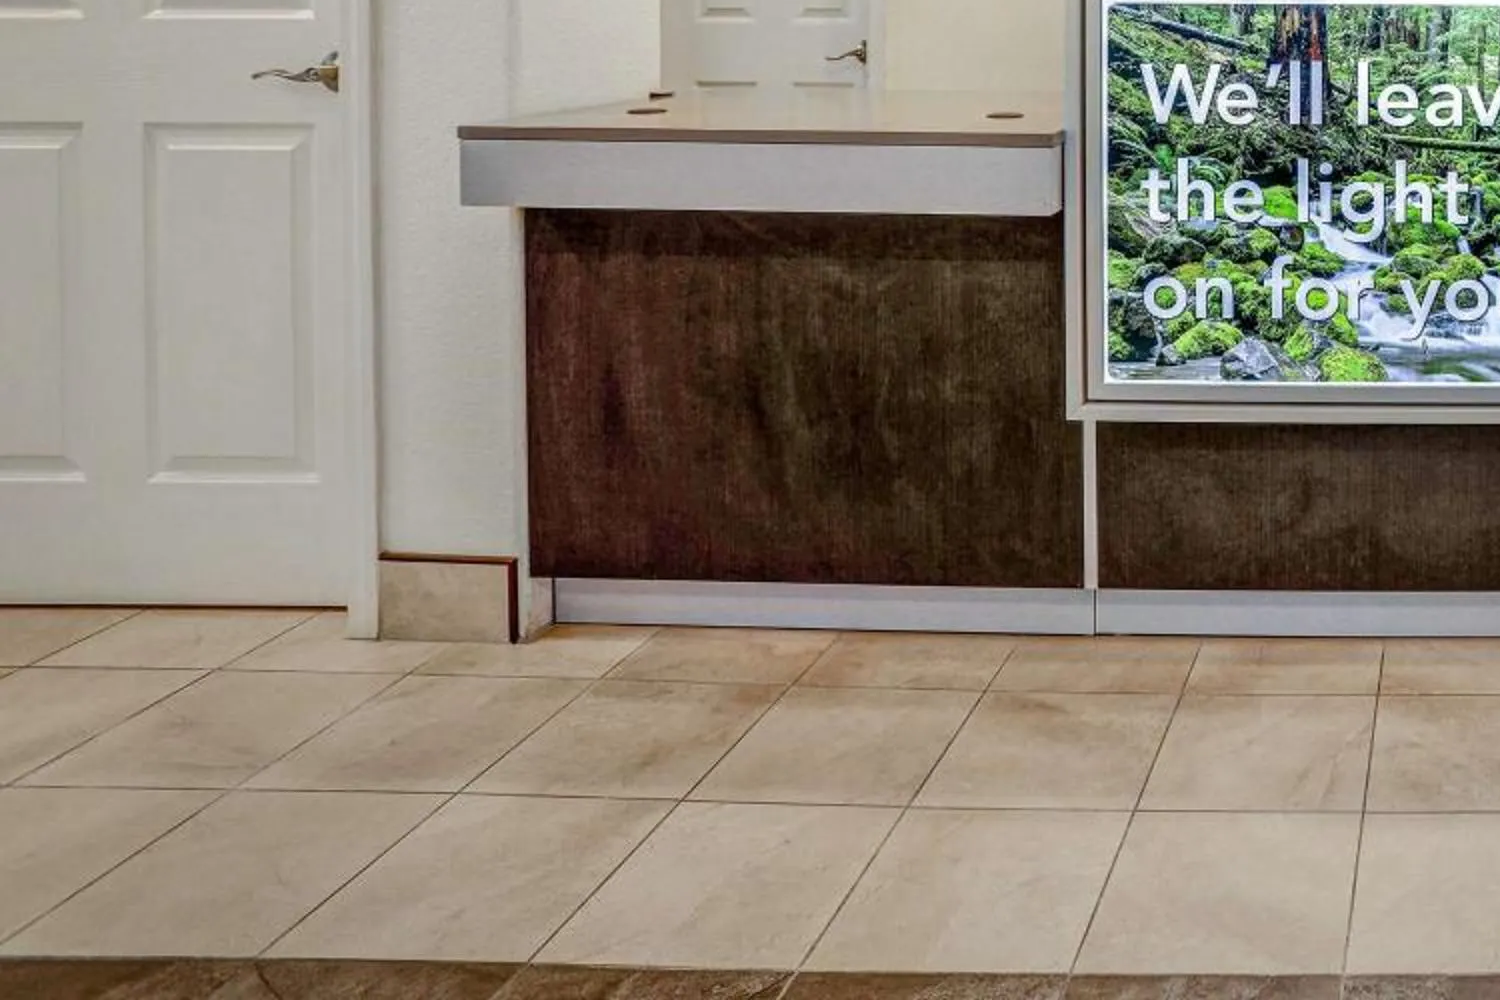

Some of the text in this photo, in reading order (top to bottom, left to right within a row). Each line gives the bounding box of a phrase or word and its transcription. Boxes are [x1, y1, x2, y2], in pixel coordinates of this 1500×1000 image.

[1141, 61, 1323, 126] We'll
[1142, 157, 1470, 243] the light
[1142, 276, 1235, 320] on
[1264, 255, 1374, 321] for
